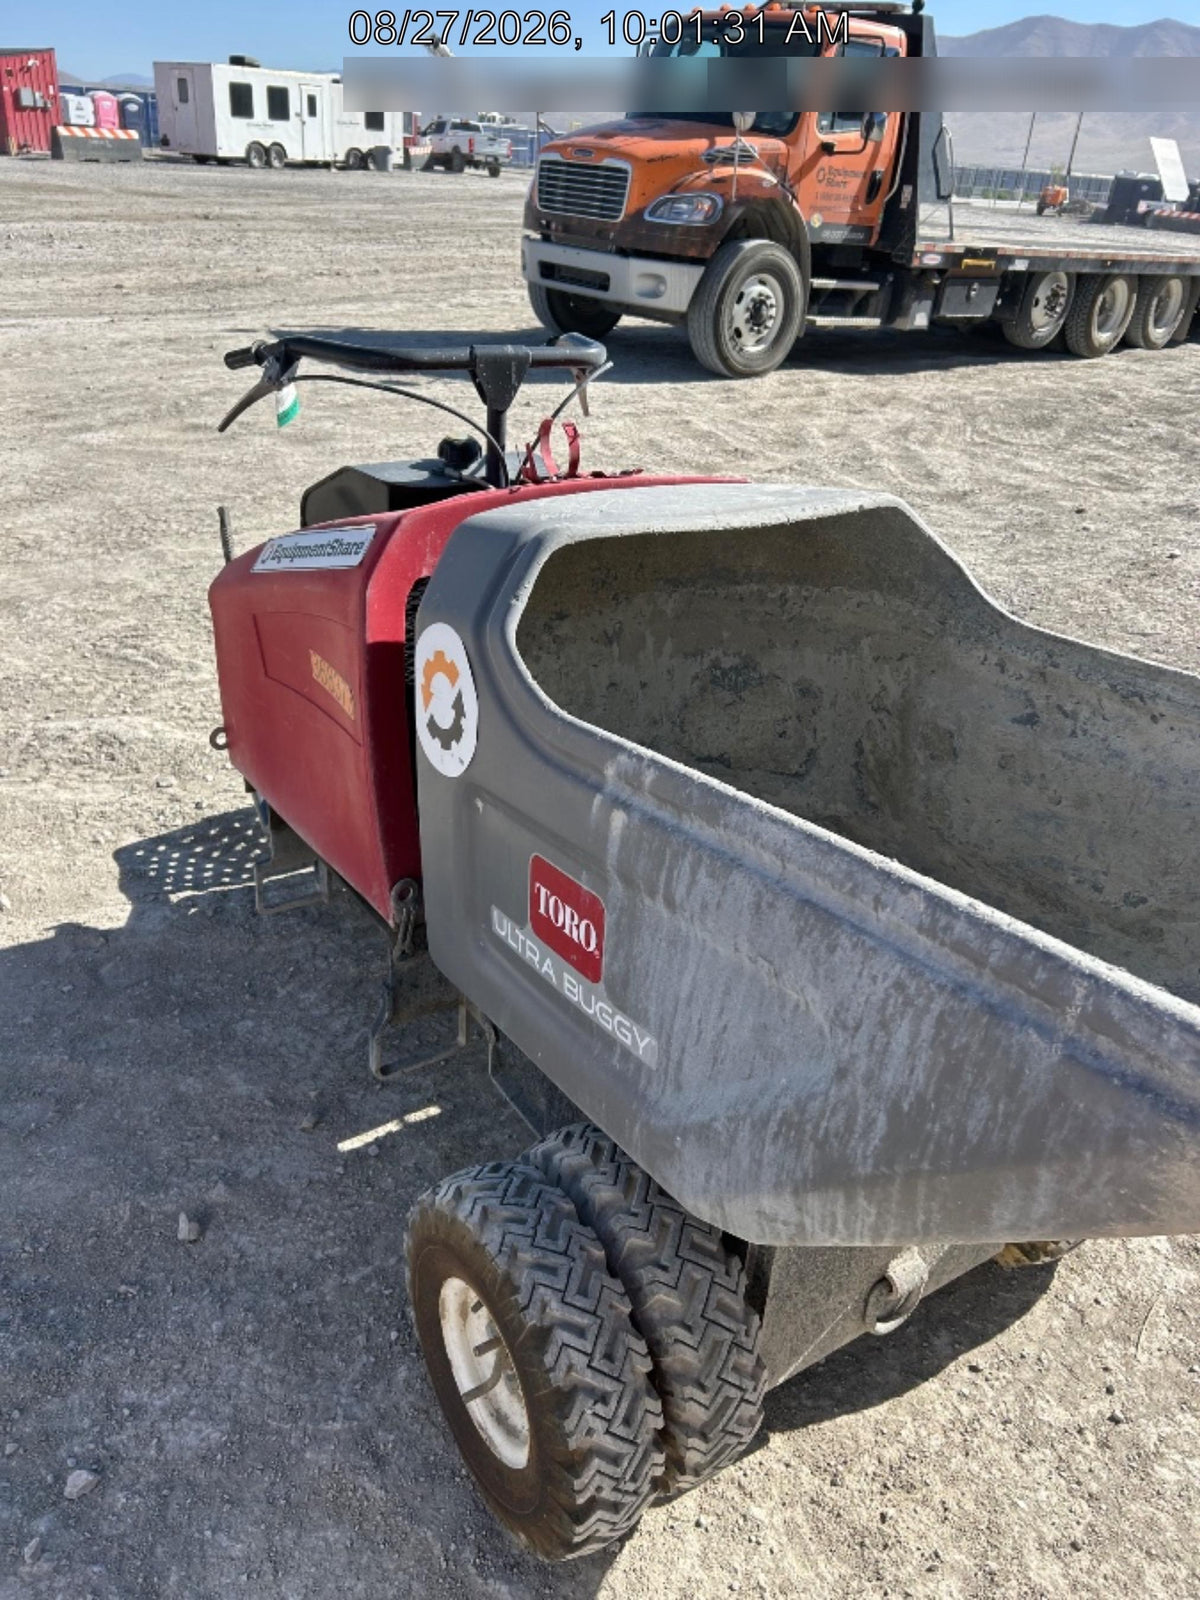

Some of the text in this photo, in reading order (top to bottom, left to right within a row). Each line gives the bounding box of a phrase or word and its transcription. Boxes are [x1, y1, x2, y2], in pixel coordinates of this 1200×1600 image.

[271, 538, 365, 564] EquipmentShare
[535, 882, 599, 953] TORO
[493, 910, 651, 1056] ULTRA BUGGY
